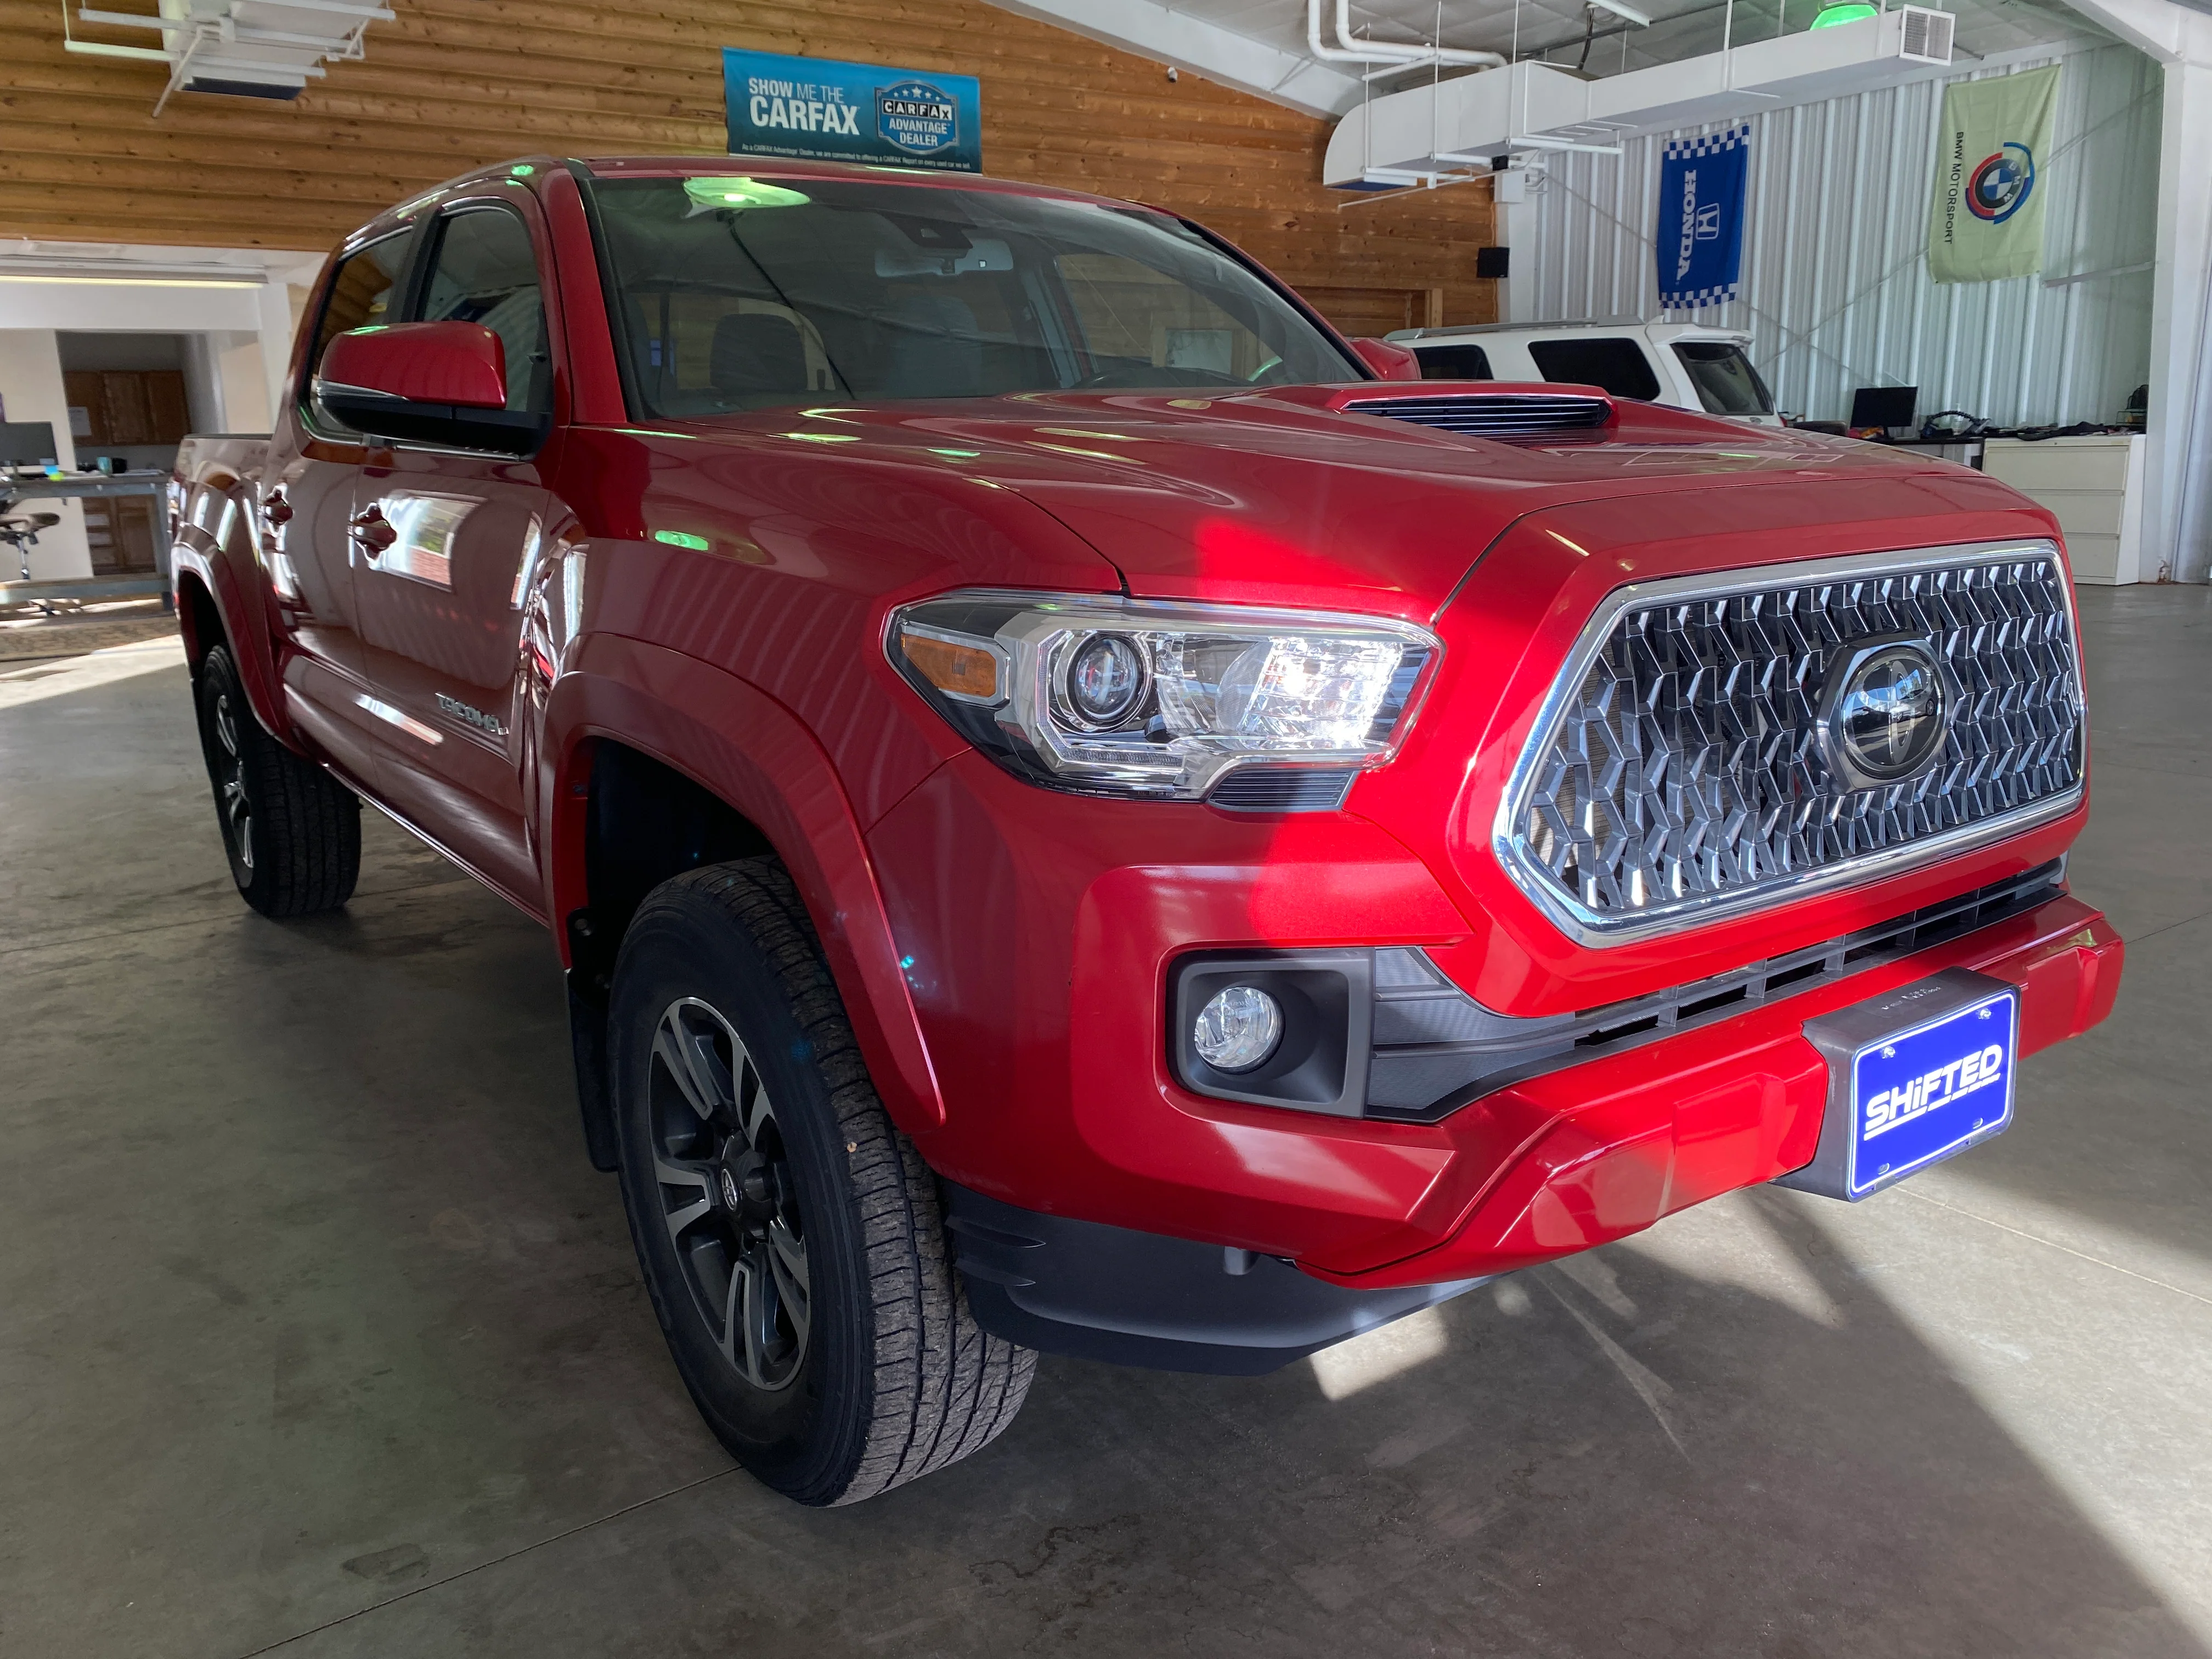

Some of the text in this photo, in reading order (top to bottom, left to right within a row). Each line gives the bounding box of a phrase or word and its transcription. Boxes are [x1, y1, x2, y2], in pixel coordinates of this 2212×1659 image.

[748, 77, 844, 104] SHOW ME THE
[750, 95, 860, 136] CARFAX
[884, 101, 949, 120] CARFAX
[889, 118, 948, 134] ADVANTAGE
[900, 132, 938, 146] DEALER
[1944, 132, 1964, 245] BMW MOTORSPORT
[1676, 170, 1697, 281] HONDA
